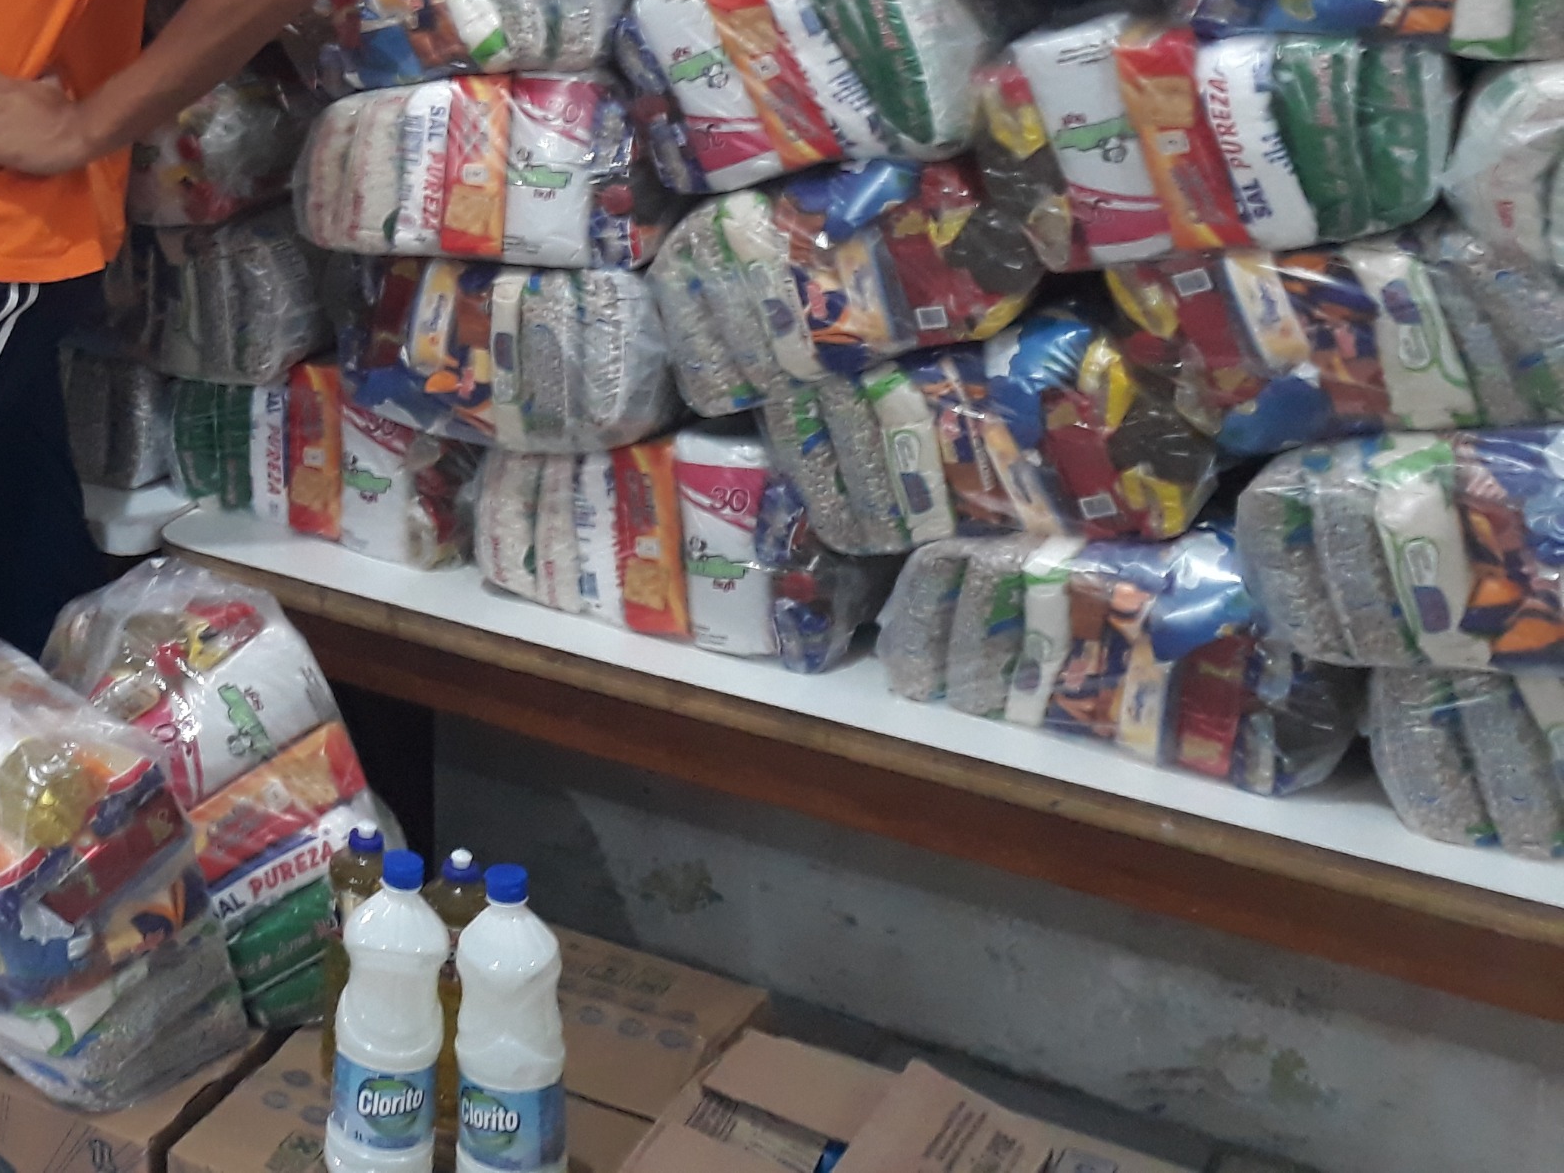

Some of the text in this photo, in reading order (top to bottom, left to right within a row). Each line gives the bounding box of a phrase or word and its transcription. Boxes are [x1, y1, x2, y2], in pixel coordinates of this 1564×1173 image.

[428, 105, 447, 142] SAL
[1207, 78, 1251, 170] PUREZA
[710, 485, 750, 516] 30
[248, 840, 334, 899] PUREZA
[358, 1087, 425, 1117] Clorito
[461, 1097, 520, 1133] Clorito
